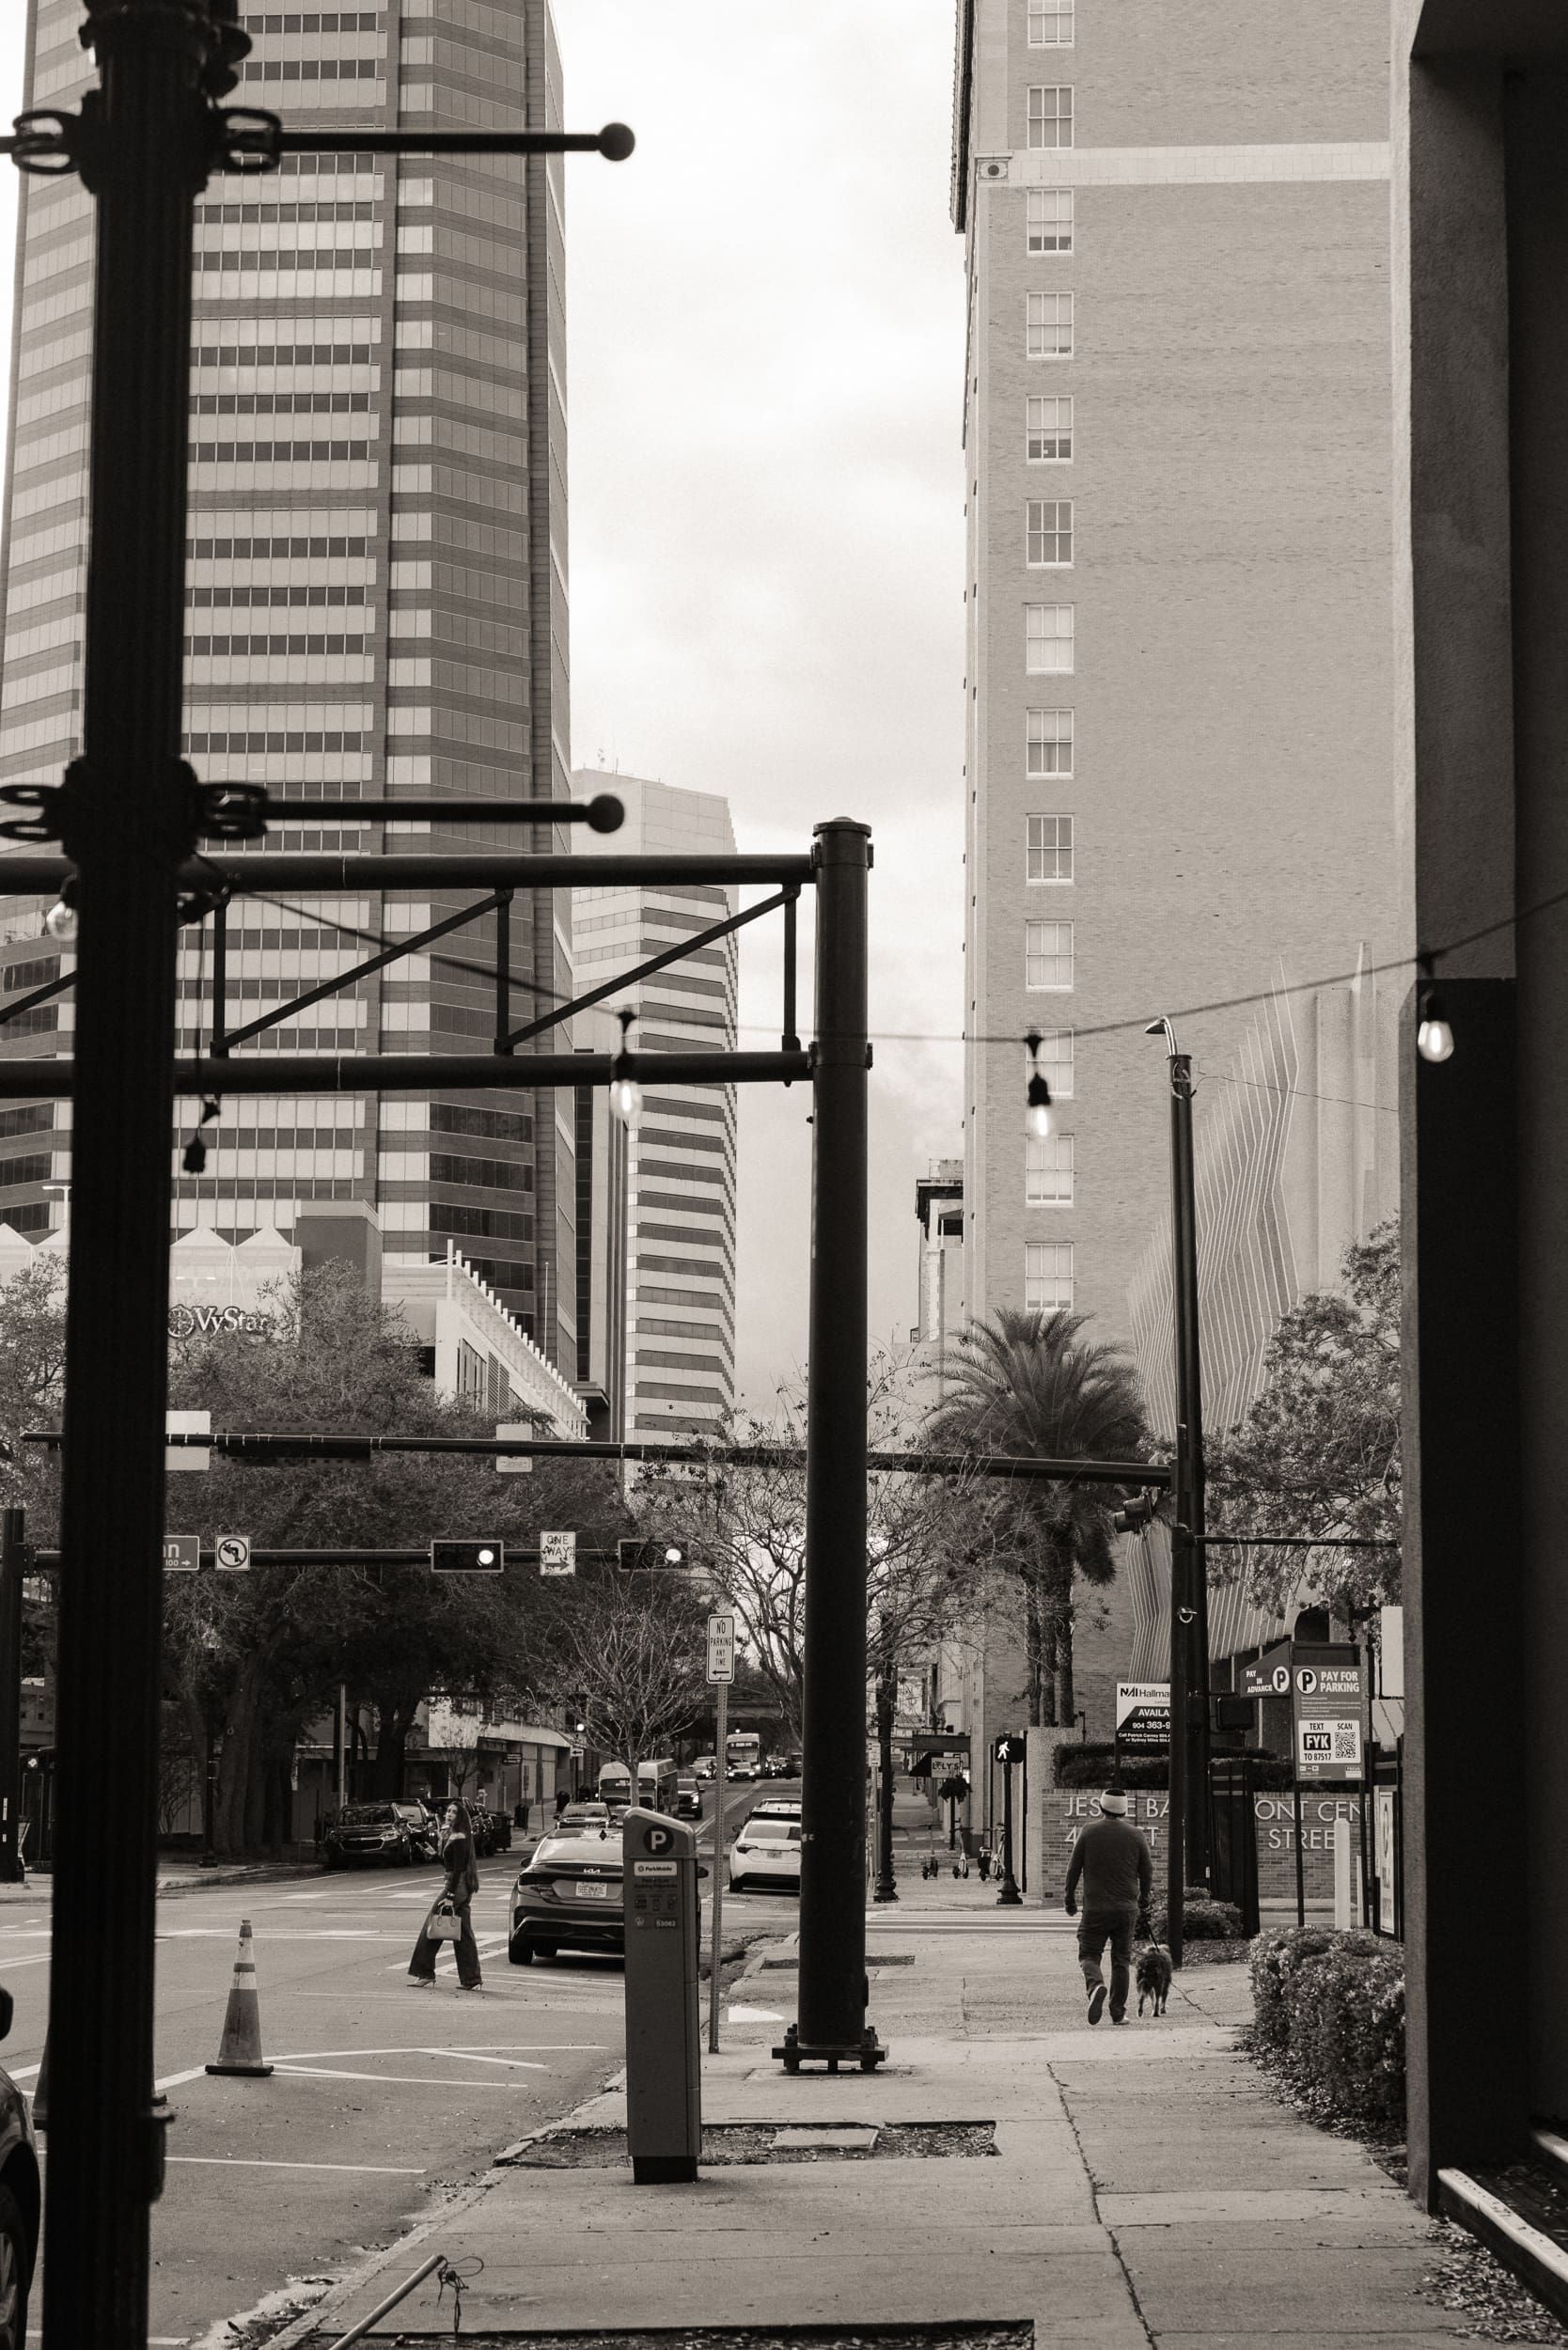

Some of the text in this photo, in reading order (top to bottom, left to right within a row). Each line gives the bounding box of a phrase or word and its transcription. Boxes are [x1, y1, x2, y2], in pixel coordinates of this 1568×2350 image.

[547, 1535, 569, 1544] ONE
[547, 1546, 569, 1558] WAY
[716, 1622, 726, 1634] NO
[710, 1637, 732, 1647] PARKING
[1321, 1671, 1358, 1682] PAY FOR
[1247, 1684, 1273, 1693] ADVANCE
[1320, 1682, 1359, 1692] PARKING
[1138, 1708, 1170, 1717] AVAILA
[1306, 1734, 1329, 1749] FYK
[1064, 1796, 1137, 1817] JESE
[651, 1830, 666, 1851] P
